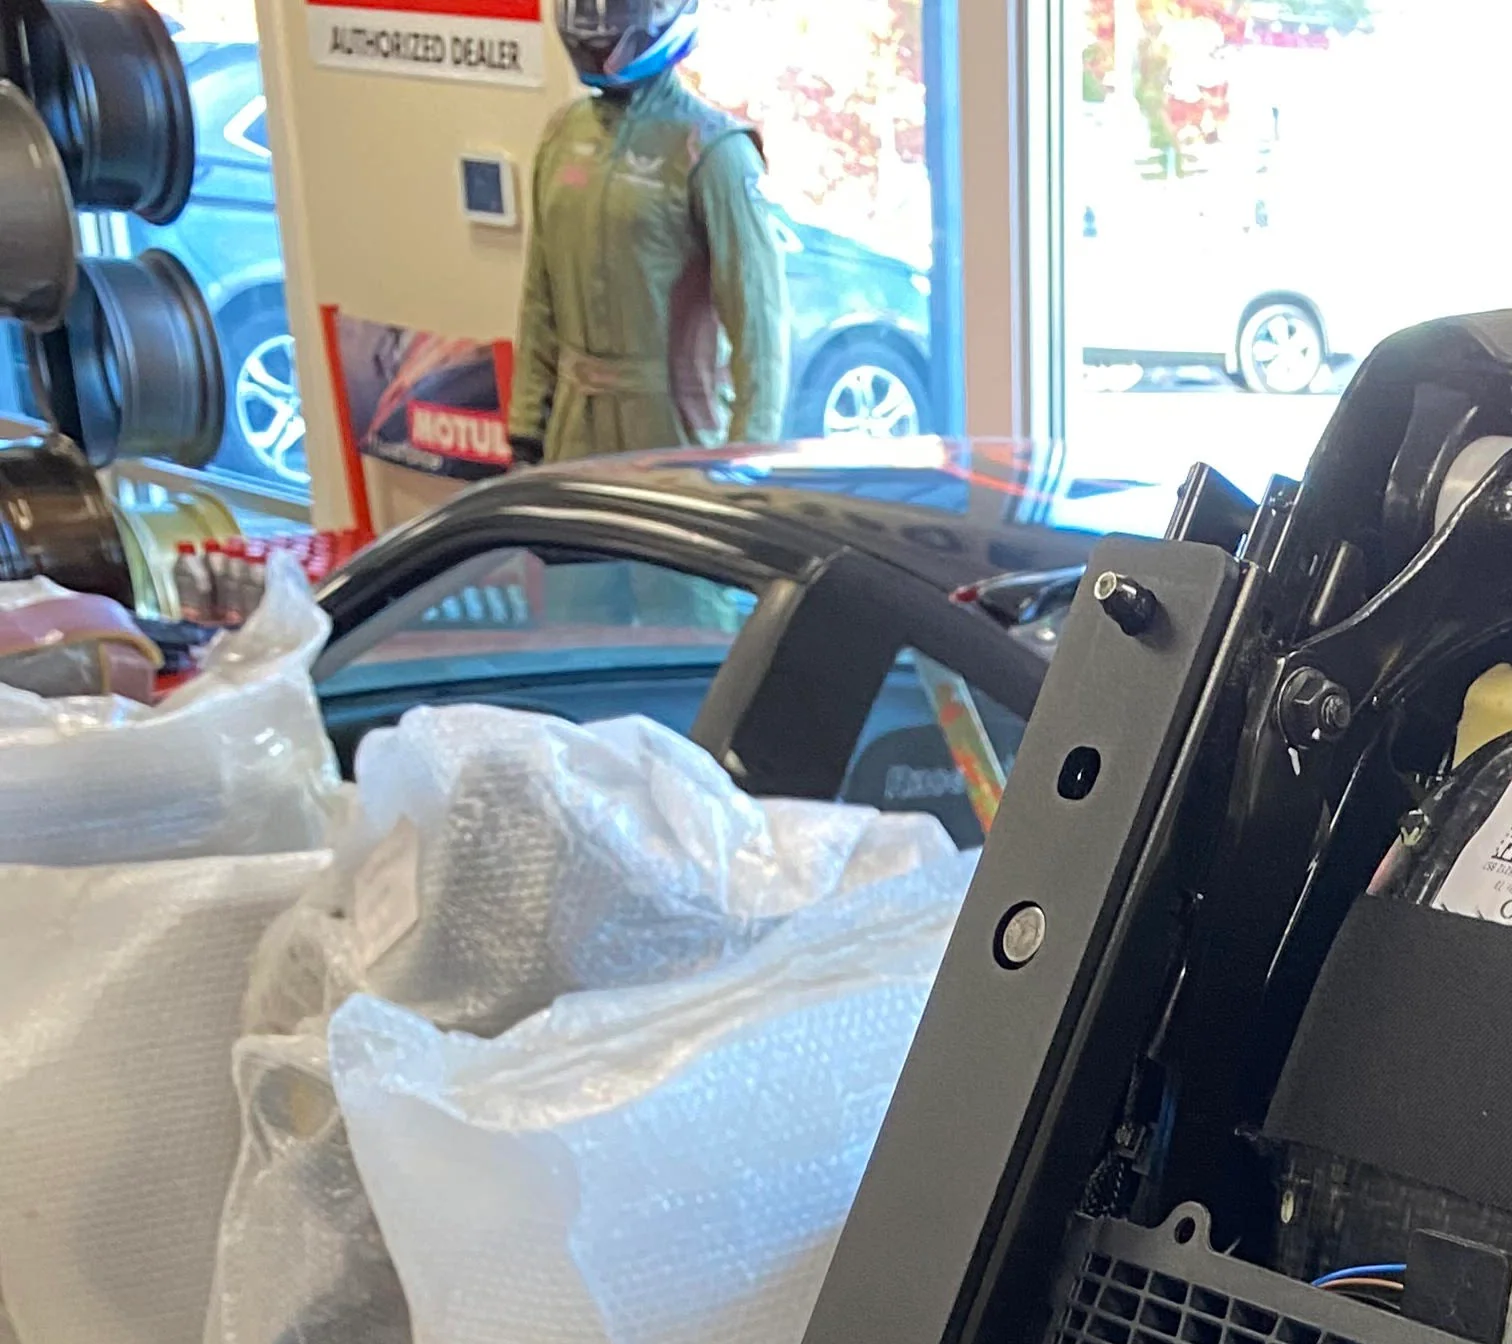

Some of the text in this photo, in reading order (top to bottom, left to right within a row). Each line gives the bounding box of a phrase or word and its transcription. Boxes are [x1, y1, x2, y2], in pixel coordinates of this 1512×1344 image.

[329, 26, 523, 72] AUTHORIZED DEALER
[412, 409, 512, 458] MOTUL
